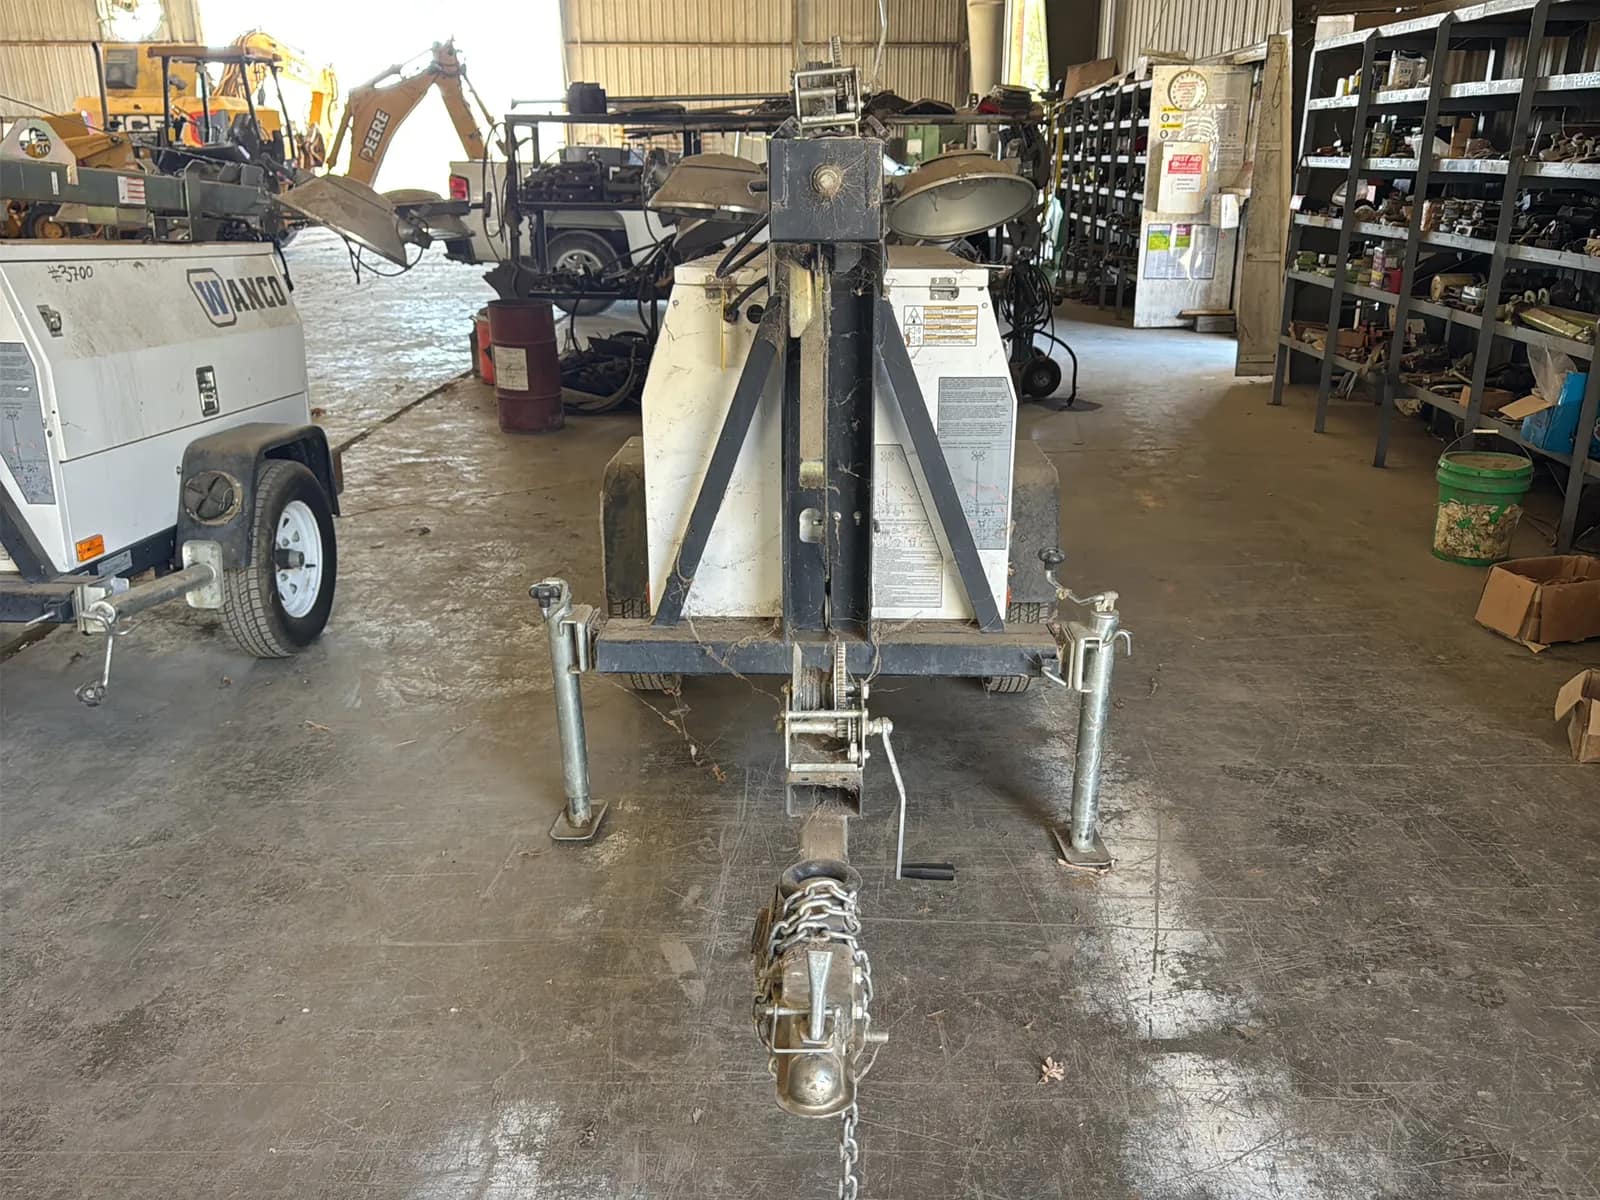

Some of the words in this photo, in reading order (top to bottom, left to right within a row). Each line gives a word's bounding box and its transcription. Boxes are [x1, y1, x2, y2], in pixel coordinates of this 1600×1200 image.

[360, 109, 390, 160] DEERE
[48, 265, 94, 282] #3700
[194, 275, 288, 317] WANCO
